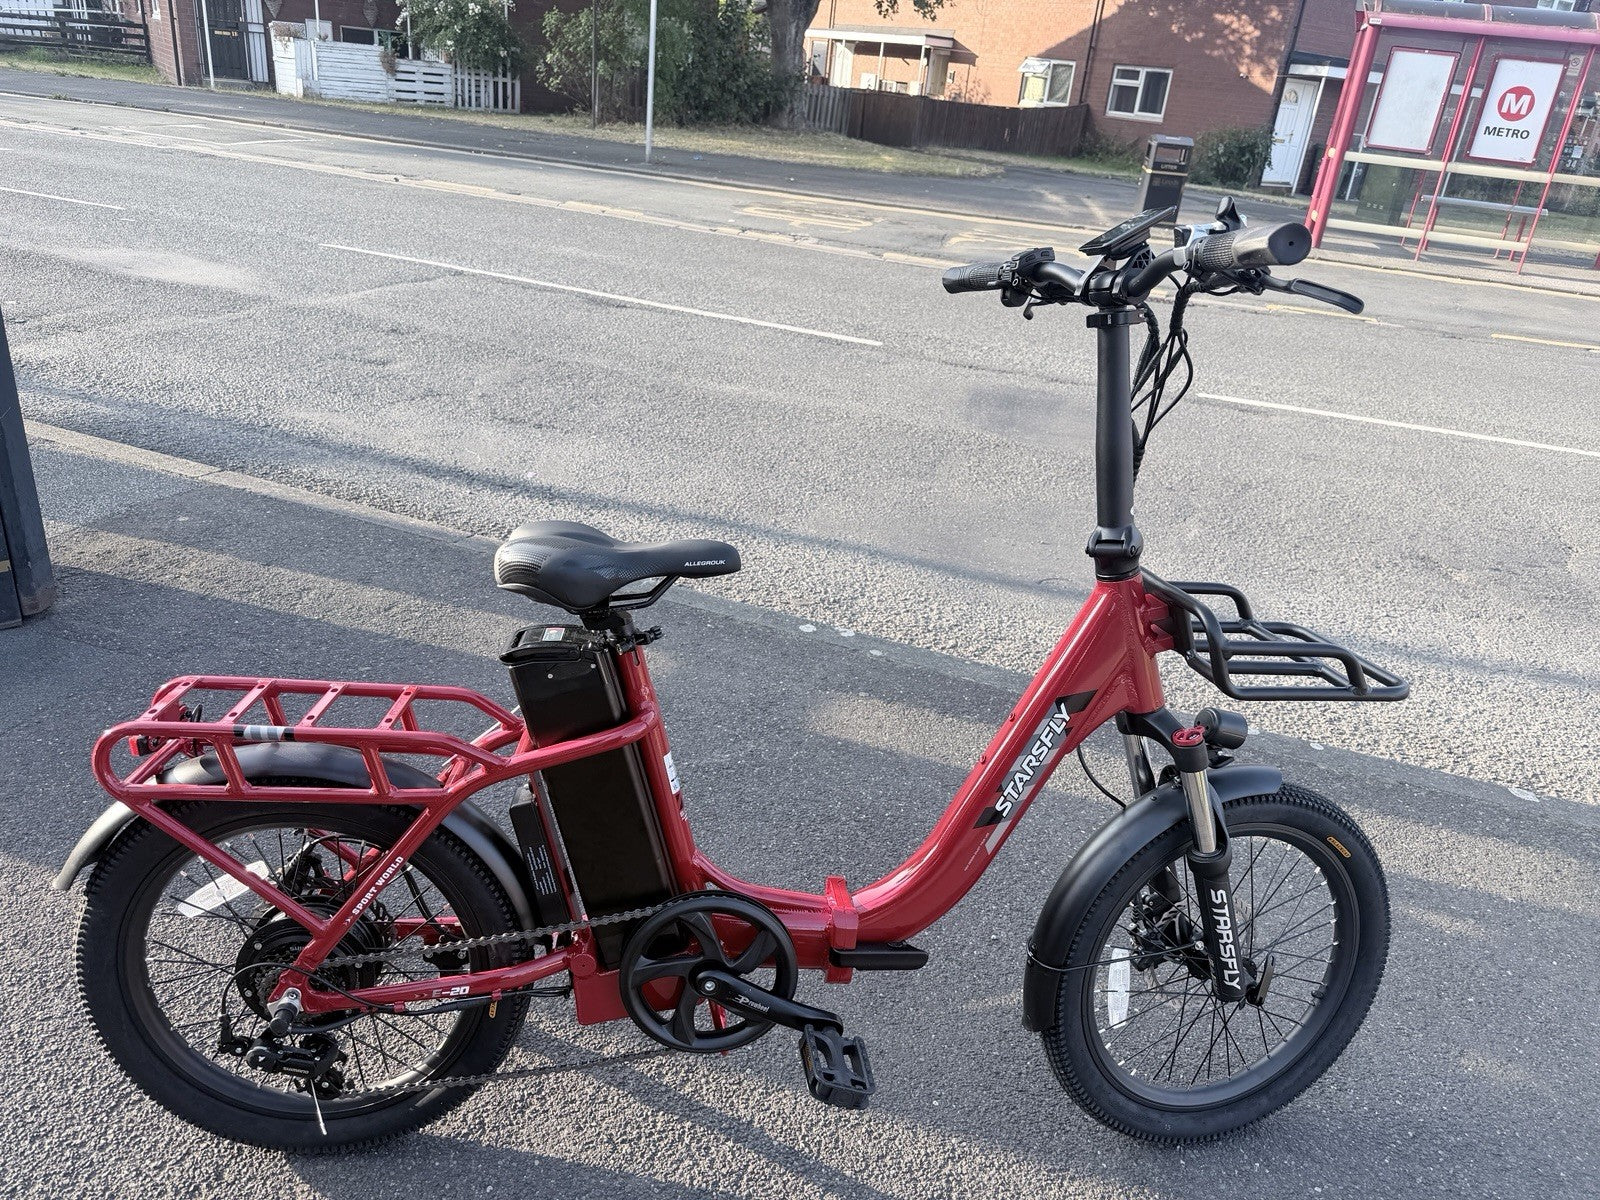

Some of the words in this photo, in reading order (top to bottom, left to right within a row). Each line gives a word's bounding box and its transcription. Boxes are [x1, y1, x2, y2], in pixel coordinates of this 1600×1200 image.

[1501, 92, 1532, 115] M
[1483, 125, 1530, 140] METRO
[684, 559, 726, 567] ALLEGROUK
[995, 702, 1071, 818] STARSFLY
[352, 886, 377, 915] SPORT
[375, 856, 404, 886] WORLD
[1210, 888, 1242, 990] STARSFLY
[432, 985, 470, 998] E-20
